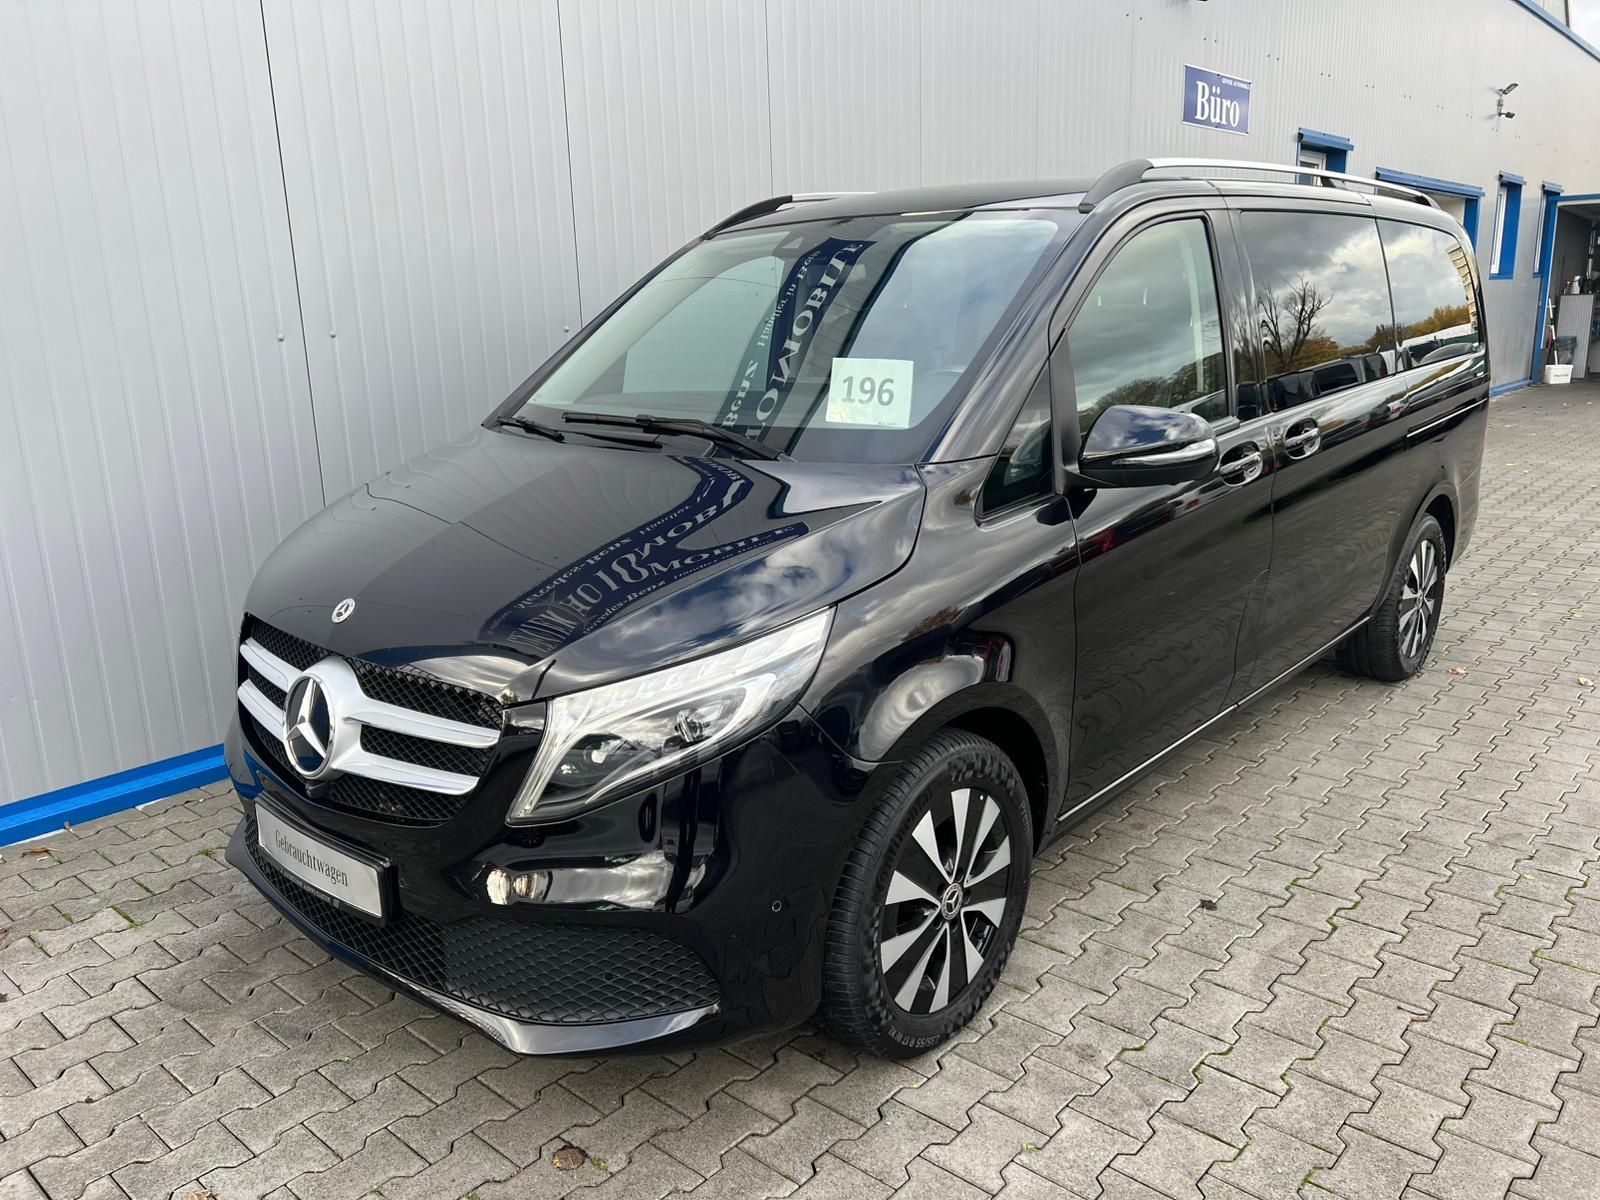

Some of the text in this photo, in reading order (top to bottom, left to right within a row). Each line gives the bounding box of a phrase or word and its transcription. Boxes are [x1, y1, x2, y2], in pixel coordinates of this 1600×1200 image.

[1195, 80, 1240, 127] Büro
[842, 375, 895, 407] 196
[275, 829, 348, 887] Gebrauchtwagen
